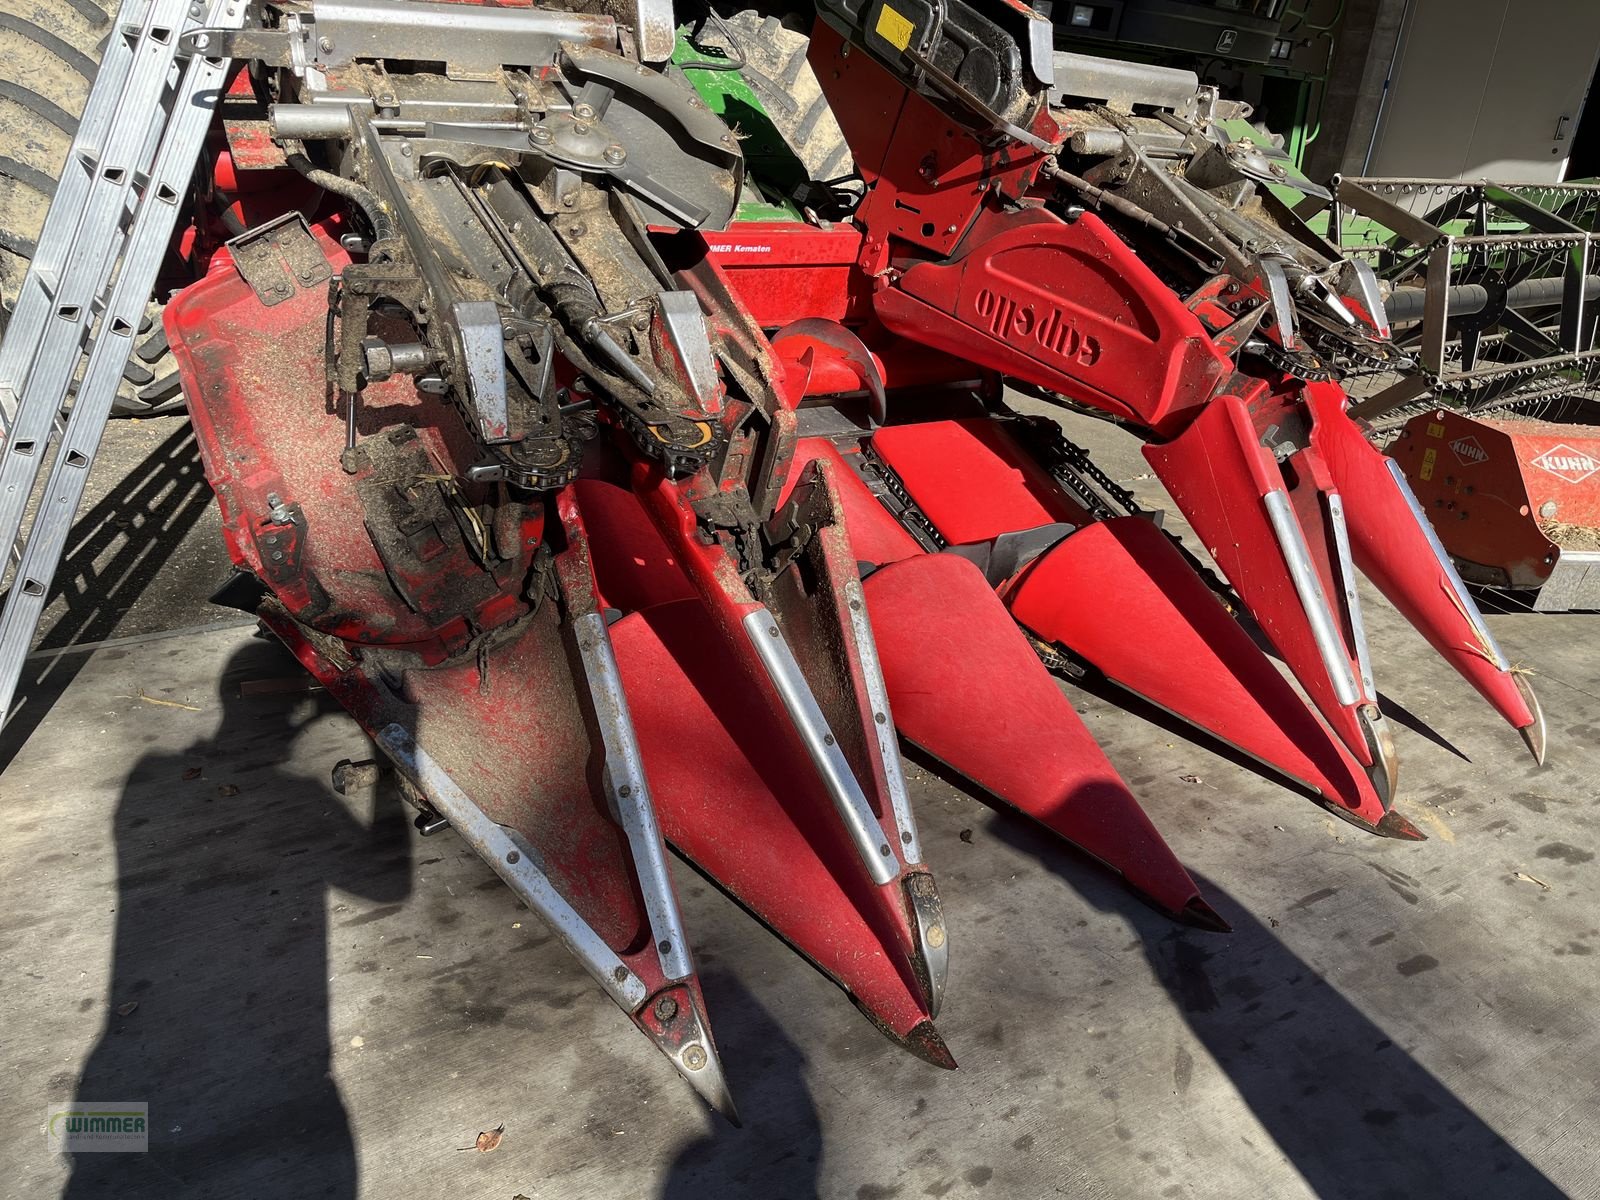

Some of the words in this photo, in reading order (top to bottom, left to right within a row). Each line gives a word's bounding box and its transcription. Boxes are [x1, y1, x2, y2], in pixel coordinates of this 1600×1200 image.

[733, 244, 771, 253] Kematen
[1453, 440, 1485, 461] KUHN
[1541, 456, 1595, 471] KUHN
